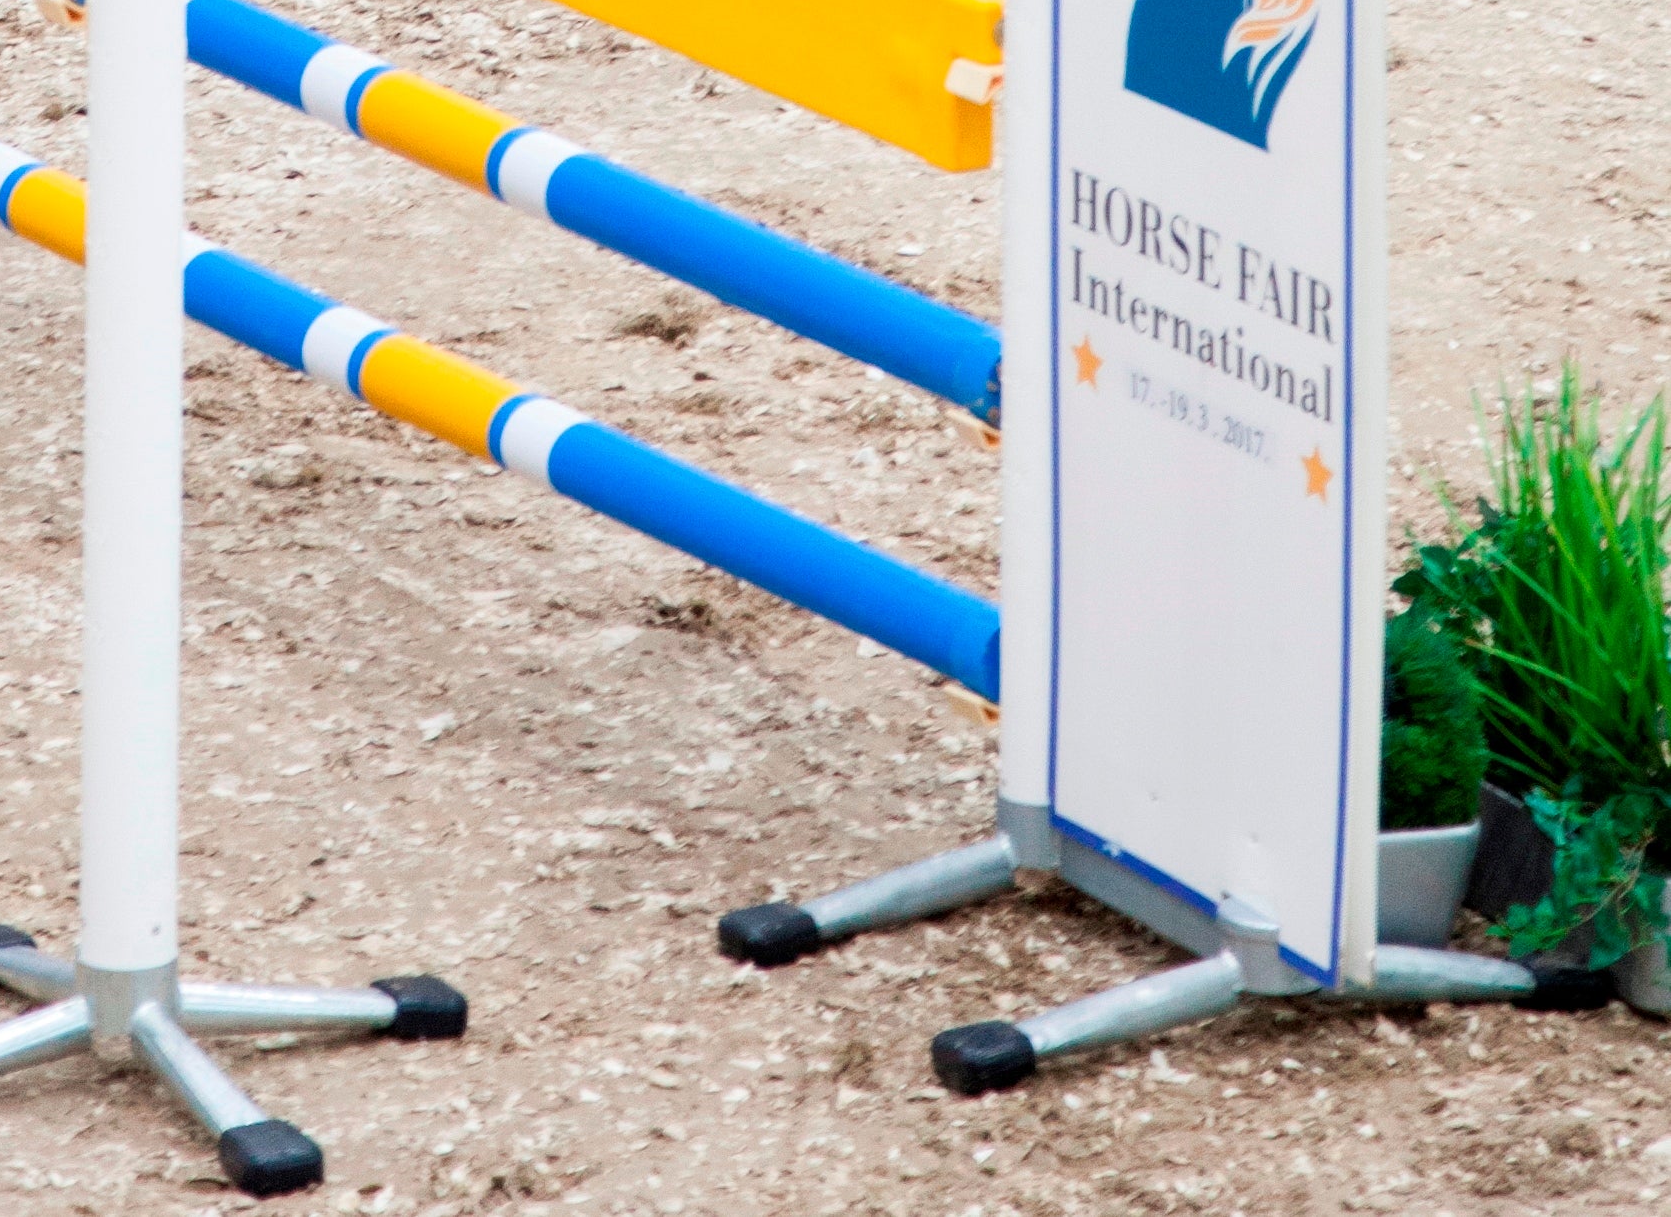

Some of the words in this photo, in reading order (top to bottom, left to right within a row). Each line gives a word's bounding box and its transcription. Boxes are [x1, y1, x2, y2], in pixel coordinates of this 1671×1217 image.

[1071, 167, 1222, 291] HORSE
[1237, 242, 1336, 346] FAIR
[1071, 245, 1334, 424] International
